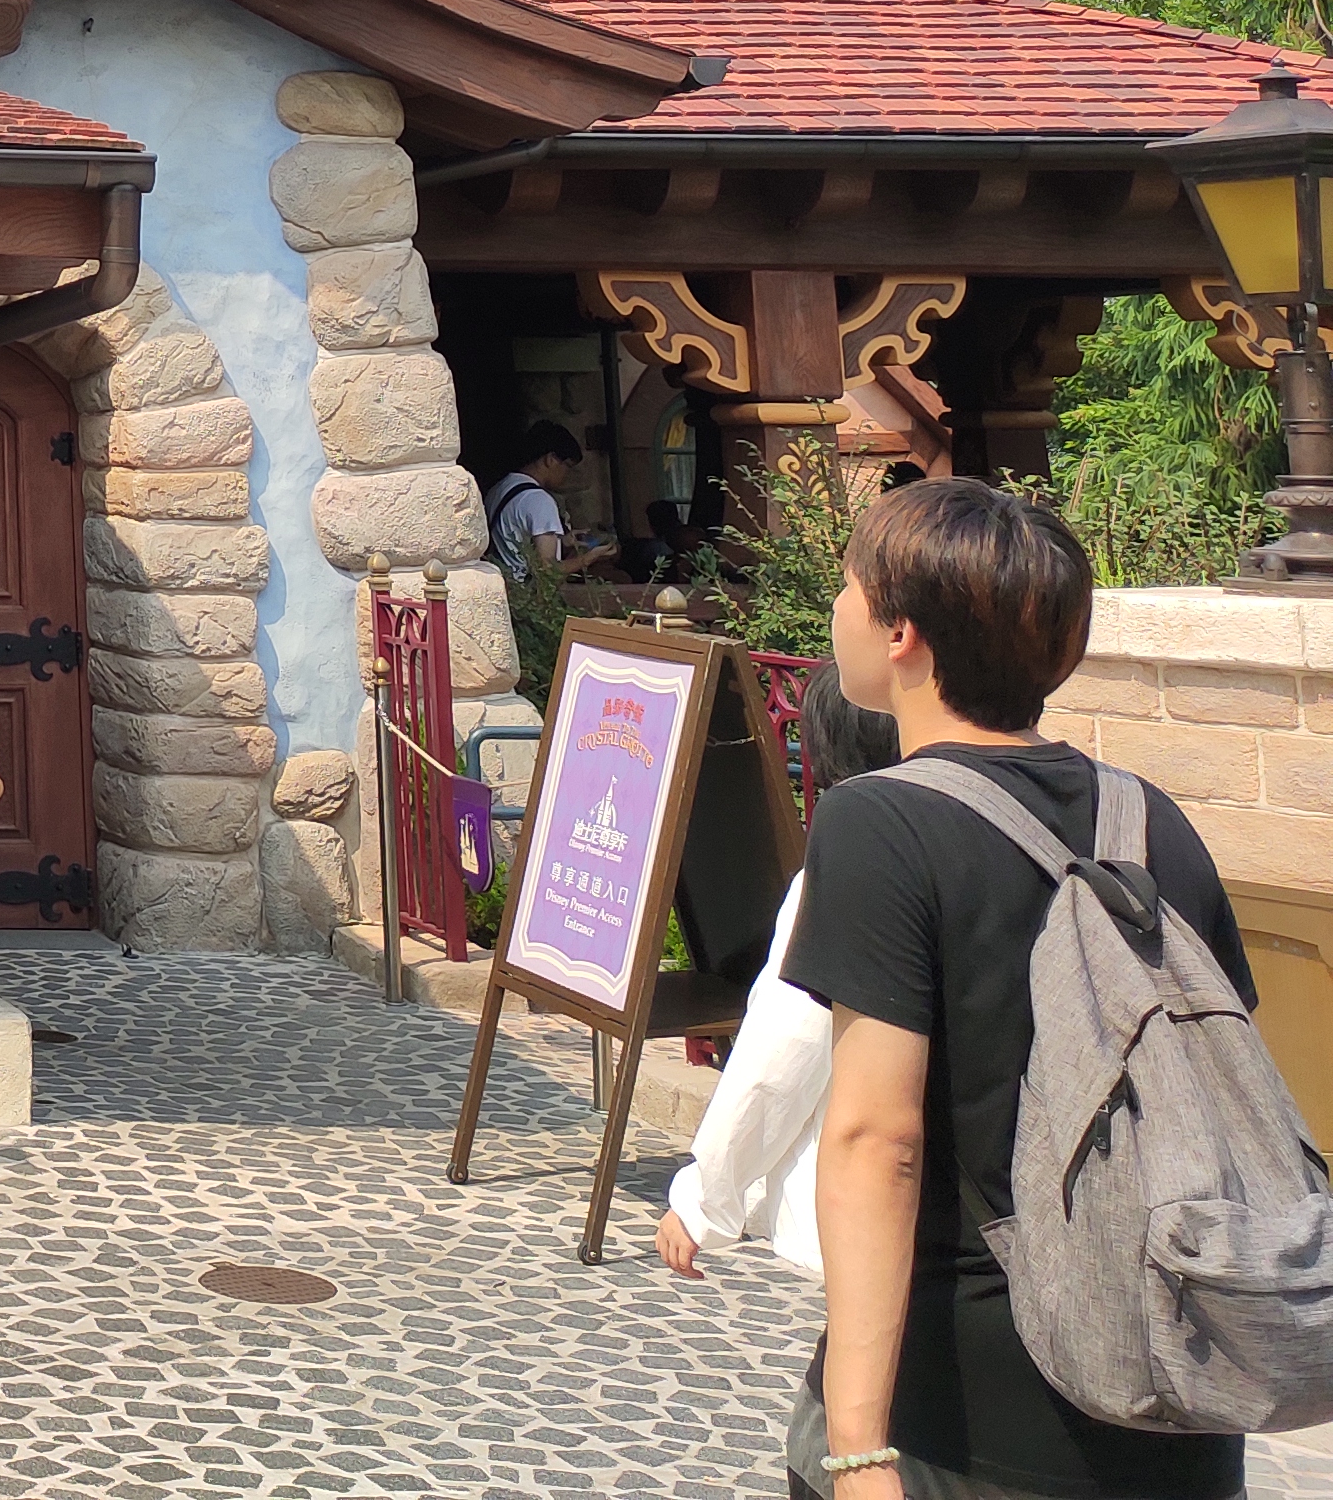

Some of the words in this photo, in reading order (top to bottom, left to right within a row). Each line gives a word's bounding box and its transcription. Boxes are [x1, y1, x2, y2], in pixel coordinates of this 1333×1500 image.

[550, 861, 629, 906] 尊享通道入口
[545, 887, 570, 910] Disney
[570, 897, 598, 918] Premier
[598, 907, 623, 927] Access
[563, 915, 595, 937] Entrance
